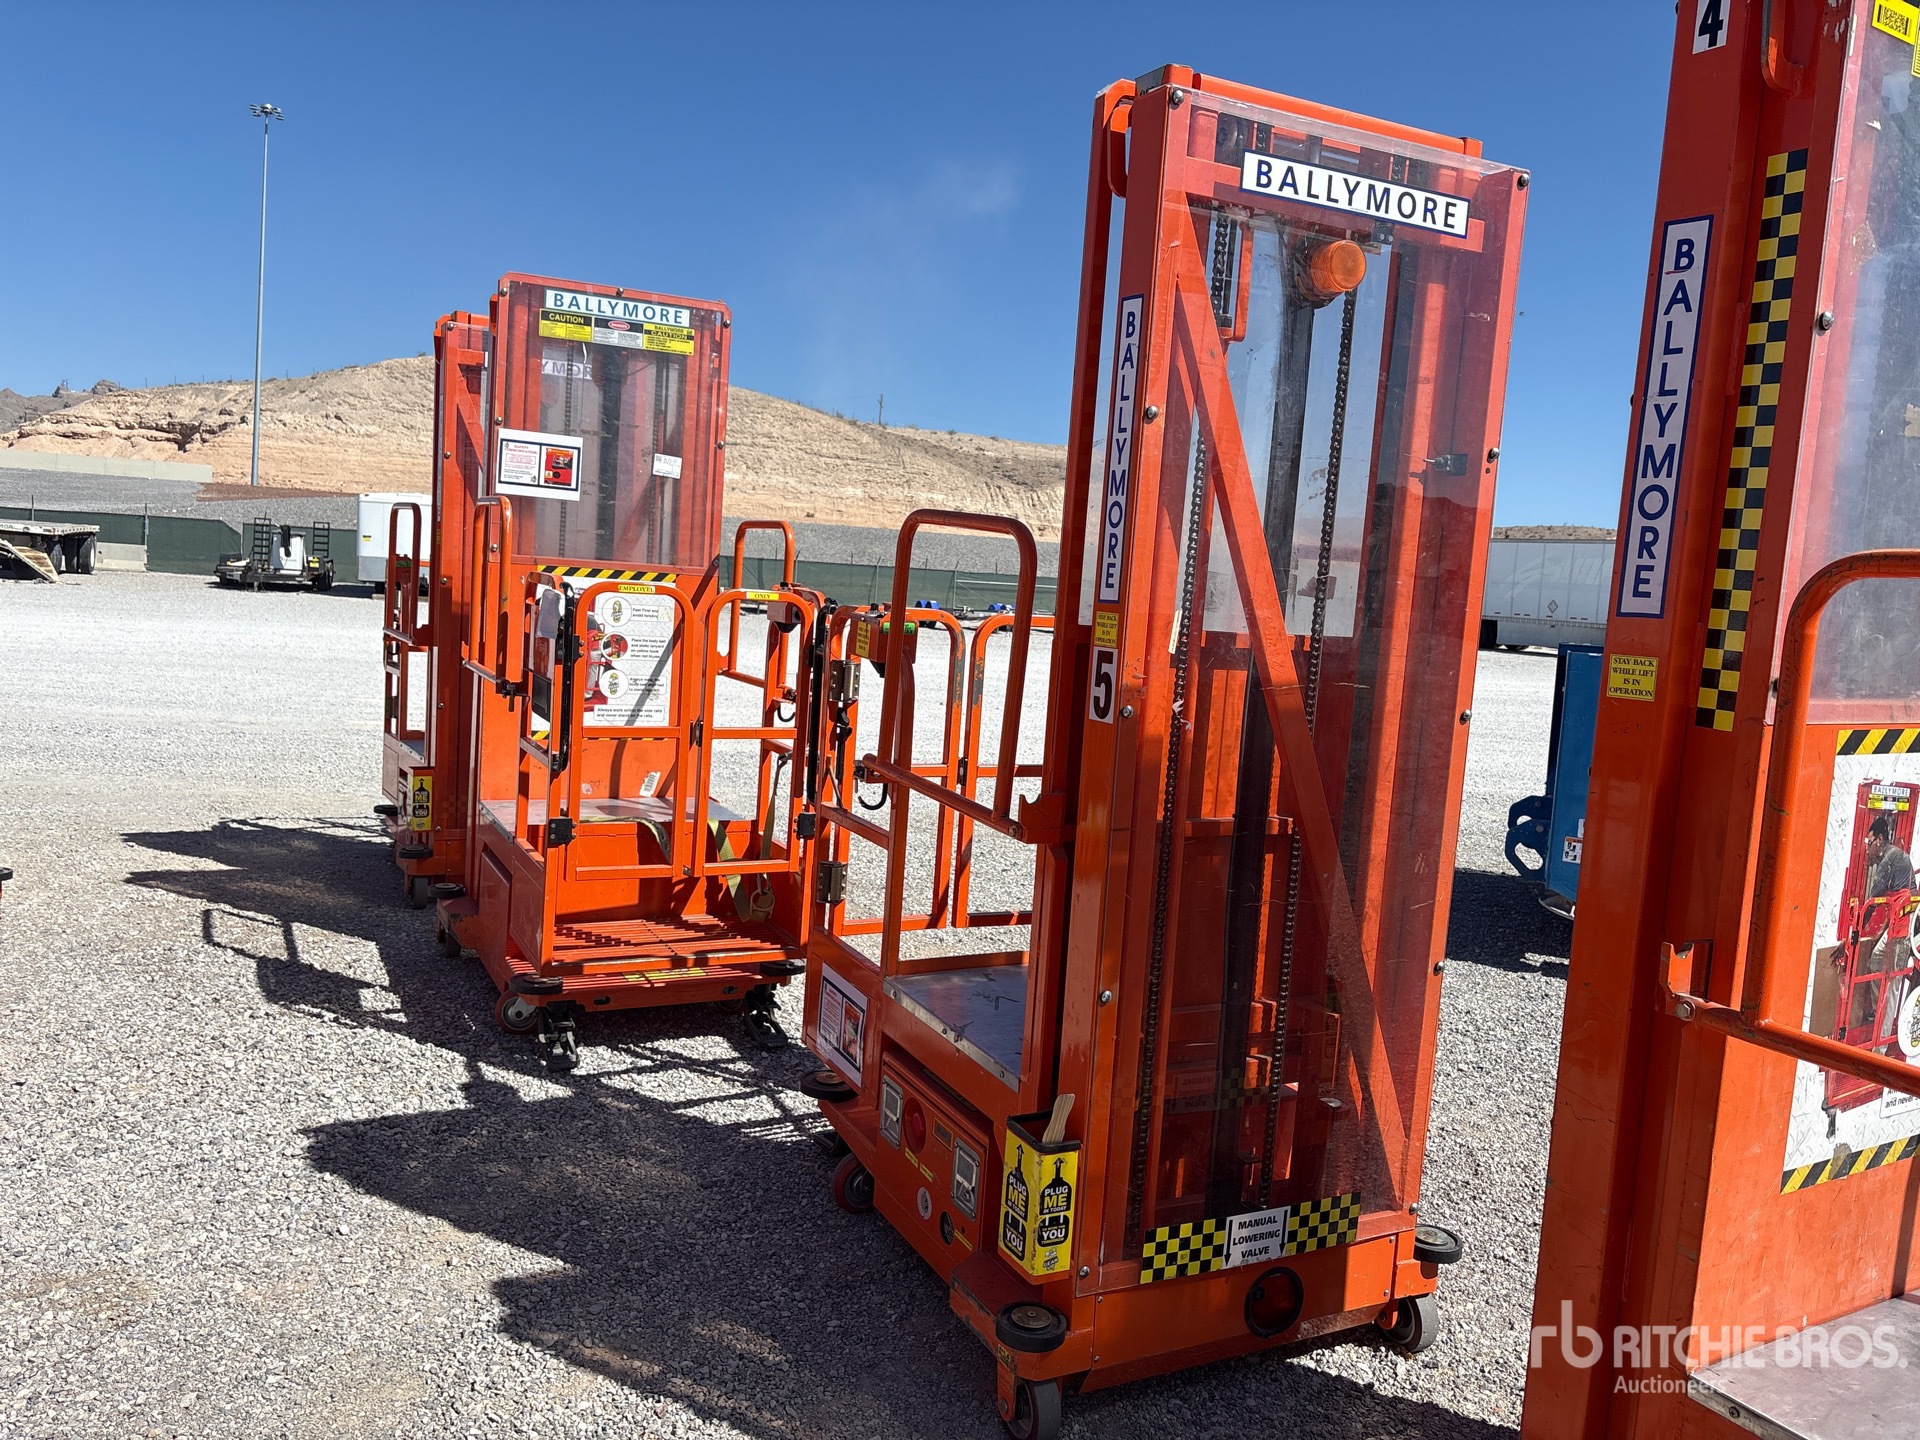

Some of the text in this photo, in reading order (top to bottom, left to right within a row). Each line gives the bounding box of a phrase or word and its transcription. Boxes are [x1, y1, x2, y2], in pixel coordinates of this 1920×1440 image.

[1698, 0, 1724, 48] 4
[1256, 159, 1458, 230] BALLYMORE
[554, 293, 683, 324] BALLYMORE
[549, 313, 584, 324] CAUTION
[650, 331, 687, 340] CAUTION
[1632, 238, 1695, 598] BALLYMORE
[1105, 311, 1136, 589] BALLYMORE
[1633, 659, 1654, 667] BACK
[1612, 667, 1655, 677] WHILE LIFT
[1093, 650, 1114, 720] 5
[1610, 686, 1653, 697] OPERATION
[1009, 1175, 1027, 1196] PLUG
[1044, 1186, 1068, 1197] PLUG
[1008, 1185, 1026, 1212] ME
[1043, 1193, 1068, 1209] ME
[1012, 1203, 1025, 1218] TODAY
[1238, 1215, 1278, 1230] MANUAL
[1006, 1228, 1023, 1252] YOU
[1042, 1228, 1065, 1240] YOU
[1232, 1229, 1281, 1246] LOWERING
[1241, 1246, 1270, 1259] VALVE
